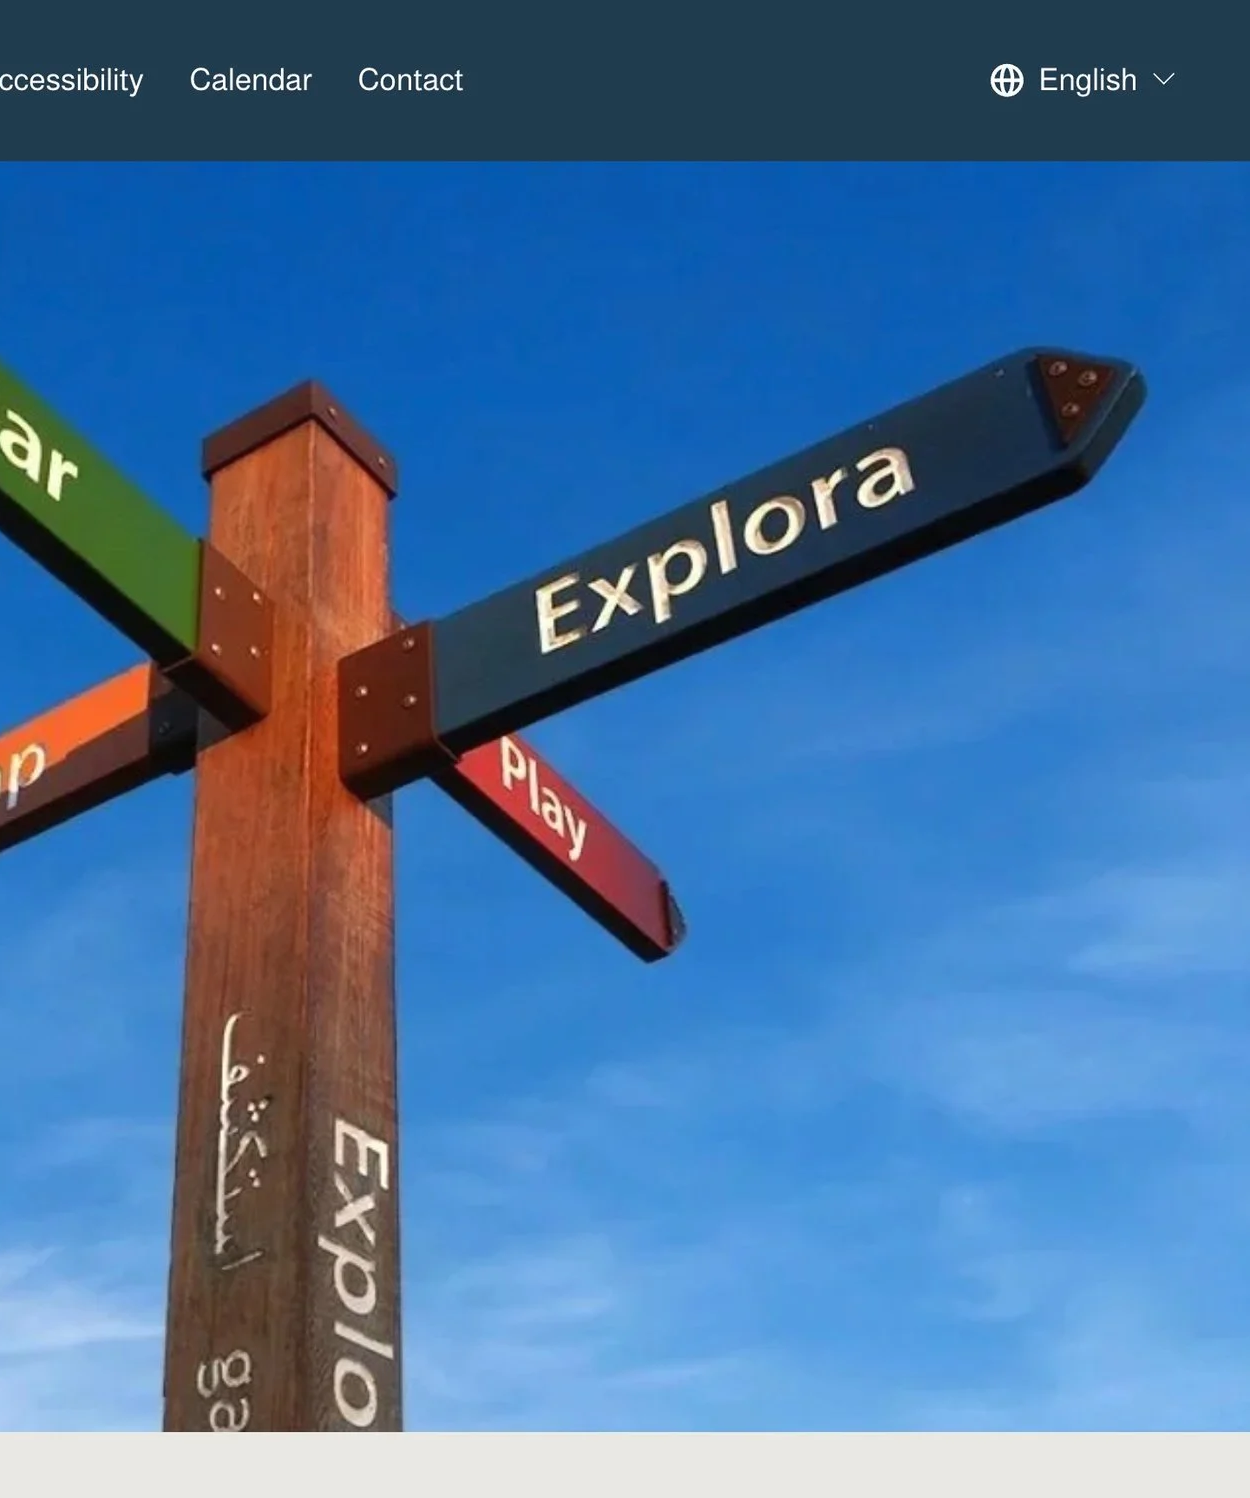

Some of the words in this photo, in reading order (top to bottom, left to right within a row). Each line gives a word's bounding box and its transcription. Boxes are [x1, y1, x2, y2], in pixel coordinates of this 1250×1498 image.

[190, 67, 313, 92] Calendar
[358, 67, 464, 92] Contact
[1040, 67, 1137, 98] English
[534, 446, 916, 654] Explora
[501, 735, 587, 861] Play
[318, 1117, 394, 1428] Explo
